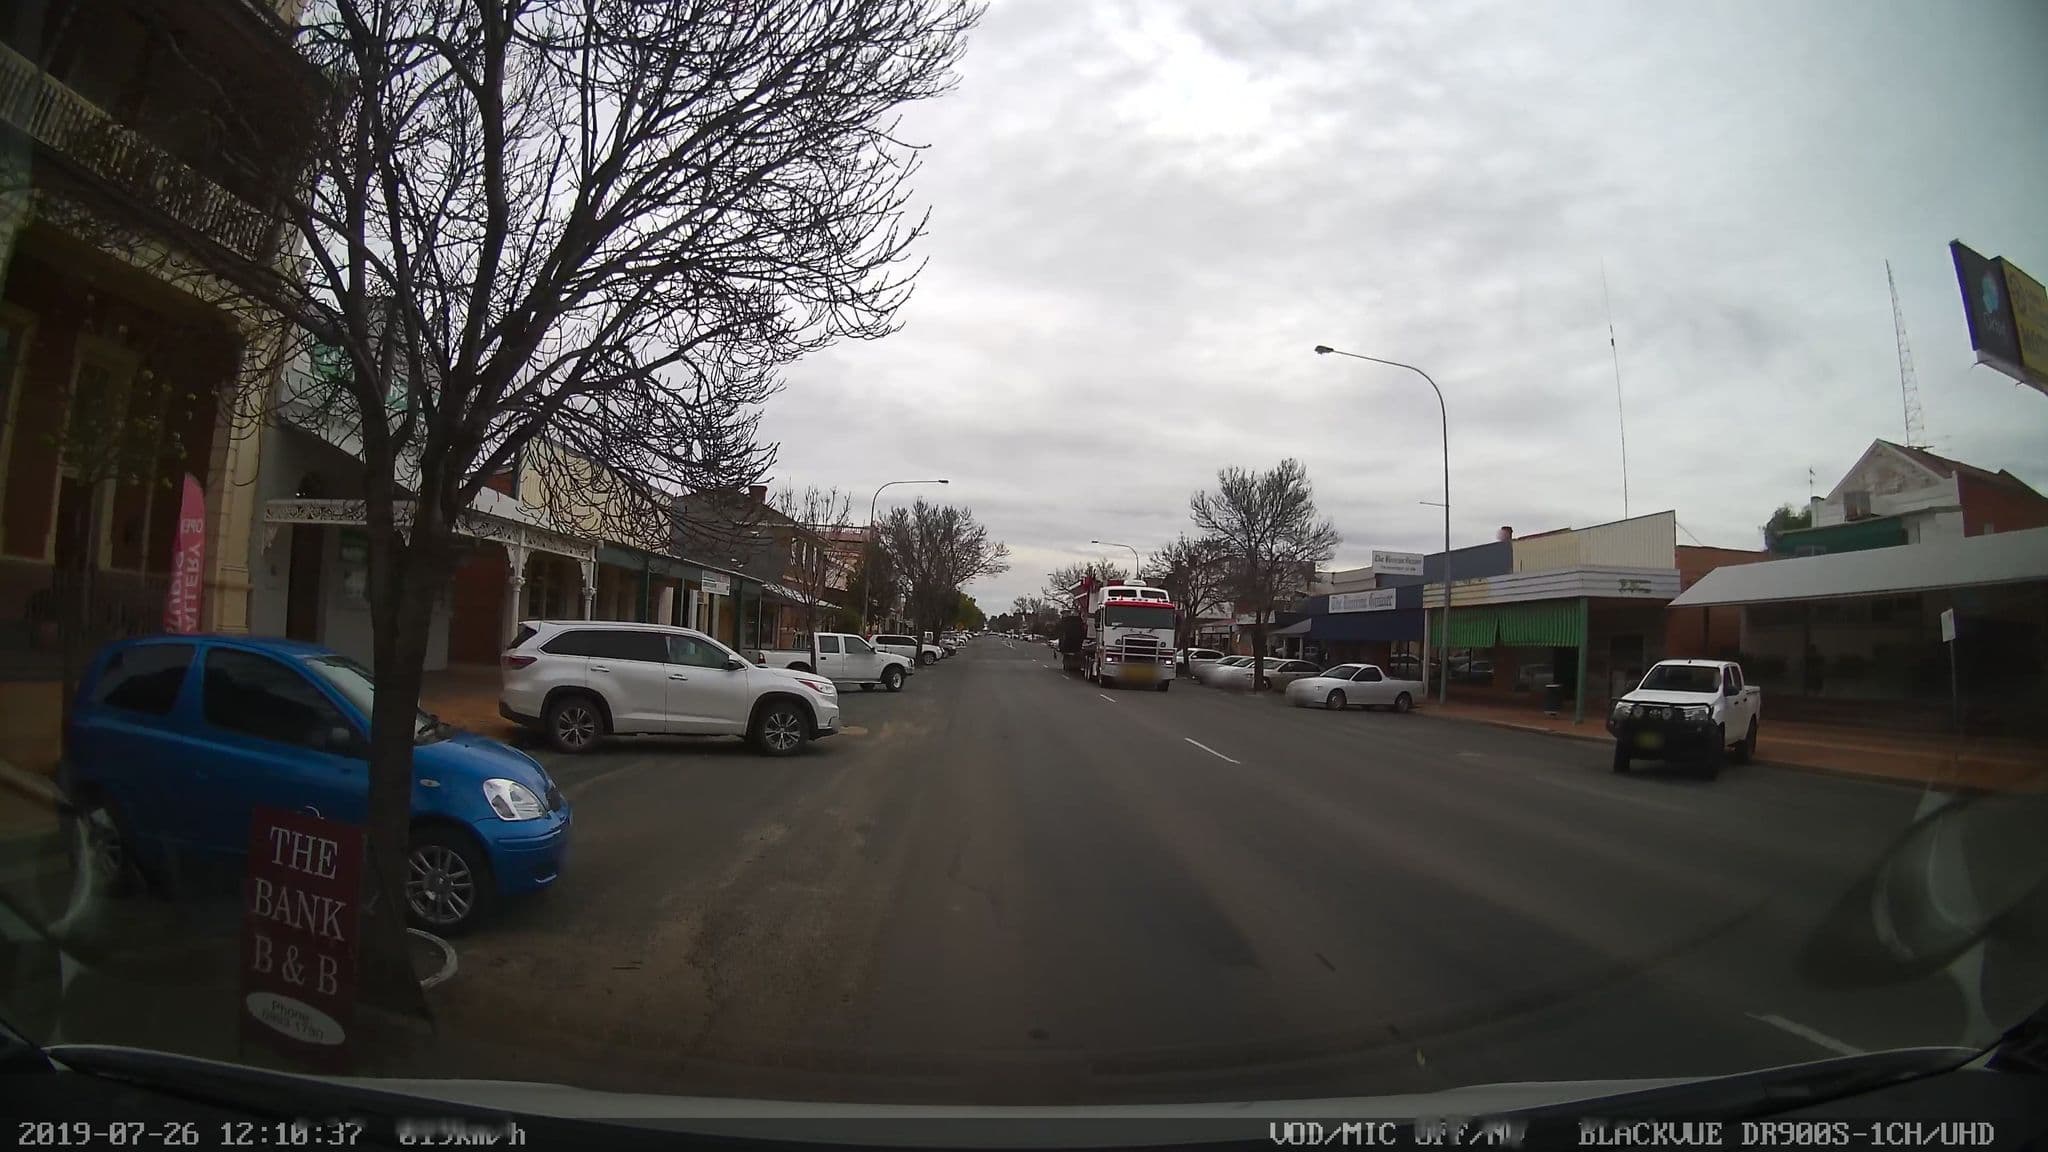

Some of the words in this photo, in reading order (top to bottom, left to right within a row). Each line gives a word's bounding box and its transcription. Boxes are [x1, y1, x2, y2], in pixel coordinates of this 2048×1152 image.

[270, 826, 338, 879] THE
[253, 877, 347, 942] BANK
[254, 935, 273, 974] B
[282, 944, 305, 985] &
[317, 954, 338, 996] B
[271, 1000, 310, 1021] Phone
